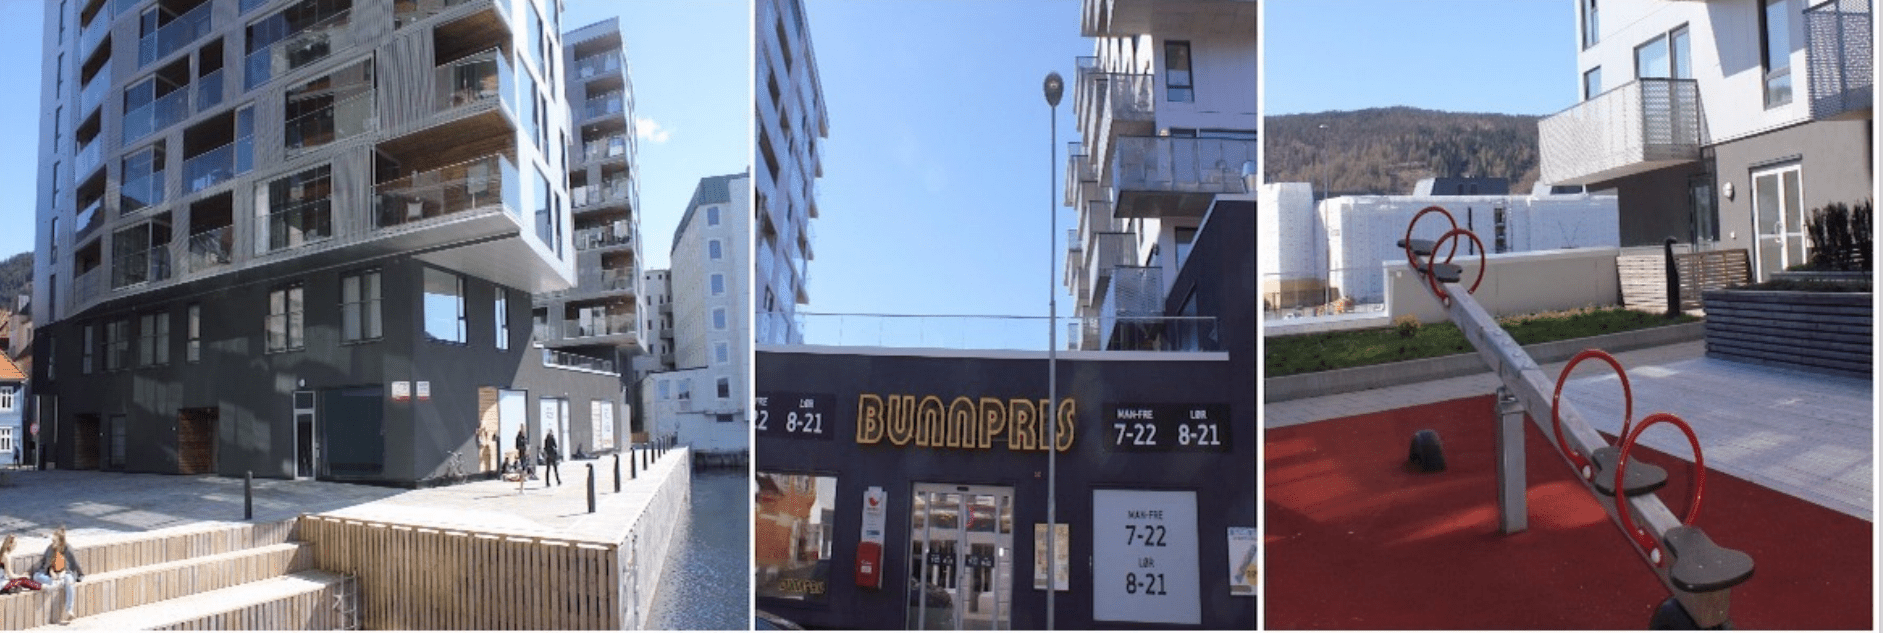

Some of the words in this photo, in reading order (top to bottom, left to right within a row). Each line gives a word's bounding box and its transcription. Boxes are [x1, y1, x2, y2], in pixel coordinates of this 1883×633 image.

[786, 411, 822, 434] 8-21
[856, 394, 1075, 451] BUNNPRIS
[1113, 423, 1157, 445] 7-22
[1178, 423, 1221, 446] 8-21
[1127, 510, 1163, 519] MAN-FRE
[1125, 525, 1167, 547] 7-22
[1126, 572, 1167, 596] 8-21
